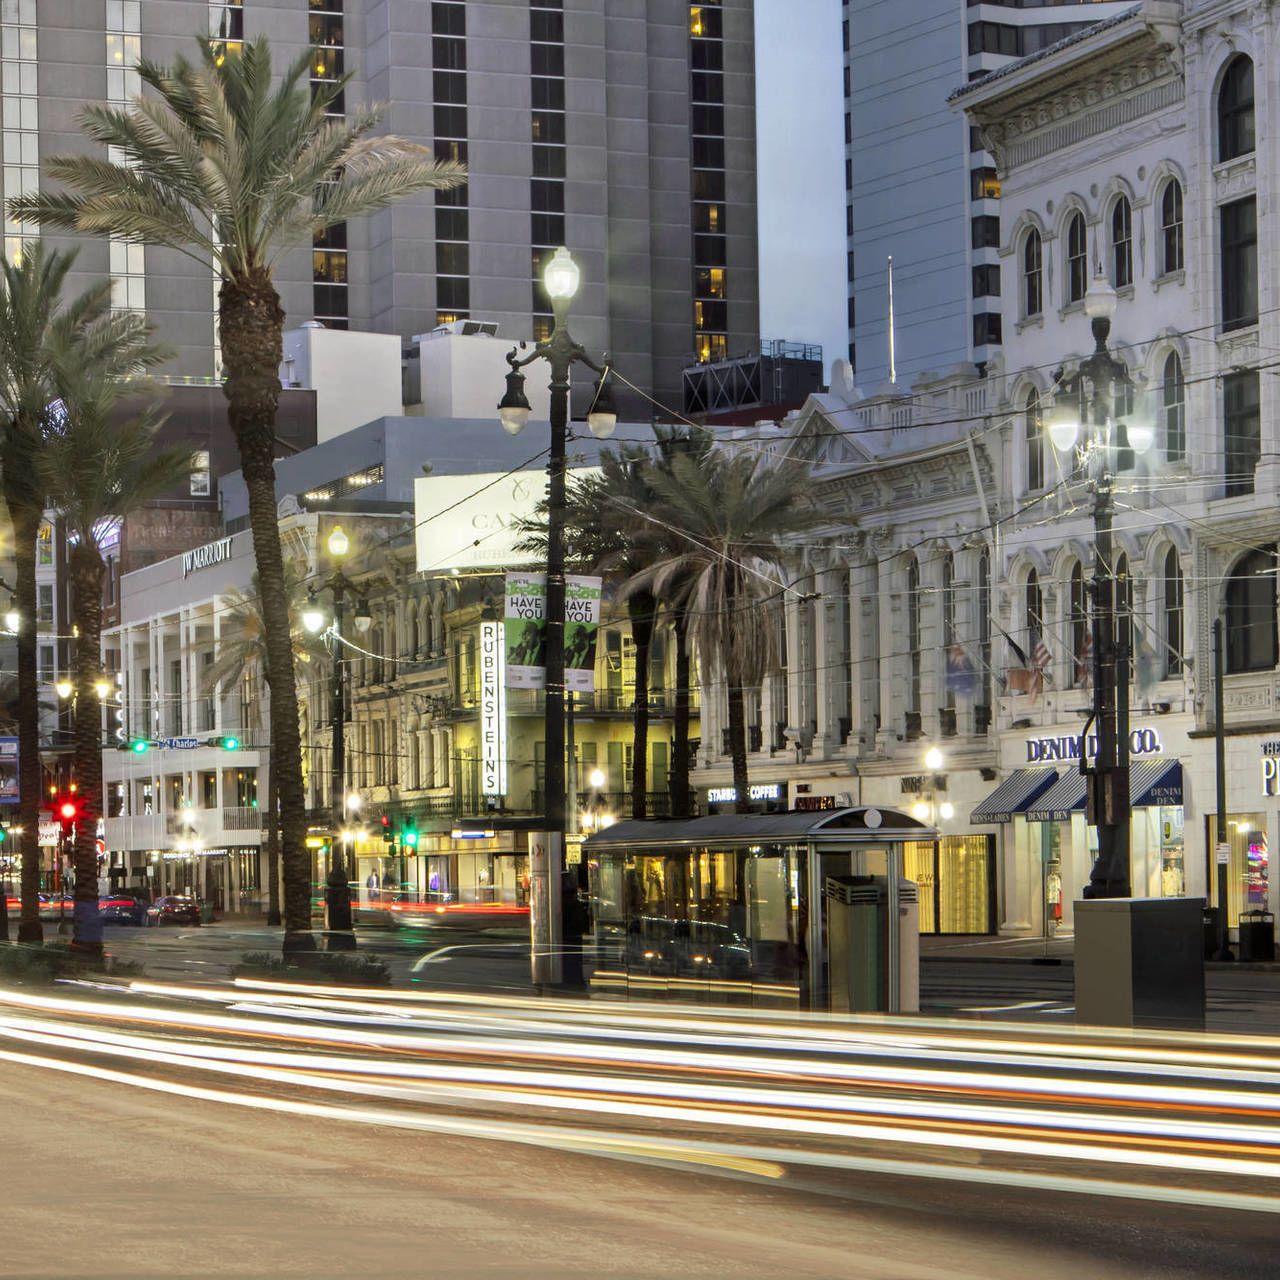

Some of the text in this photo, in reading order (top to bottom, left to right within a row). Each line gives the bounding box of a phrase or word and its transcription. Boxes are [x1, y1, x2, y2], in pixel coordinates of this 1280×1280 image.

[510, 597, 542, 609] HAVE
[517, 609, 543, 620] YOU
[567, 612, 593, 623] YOU
[483, 626, 495, 789] RUBENSTEINS
[1025, 735, 1082, 762] DENIM
[708, 787, 750, 803] STARBU
[750, 784, 779, 801] COFFEE
[1150, 787, 1182, 797] DENIM
[1156, 796, 1176, 805] DEN
[1027, 810, 1068, 821] DENIM DEN
